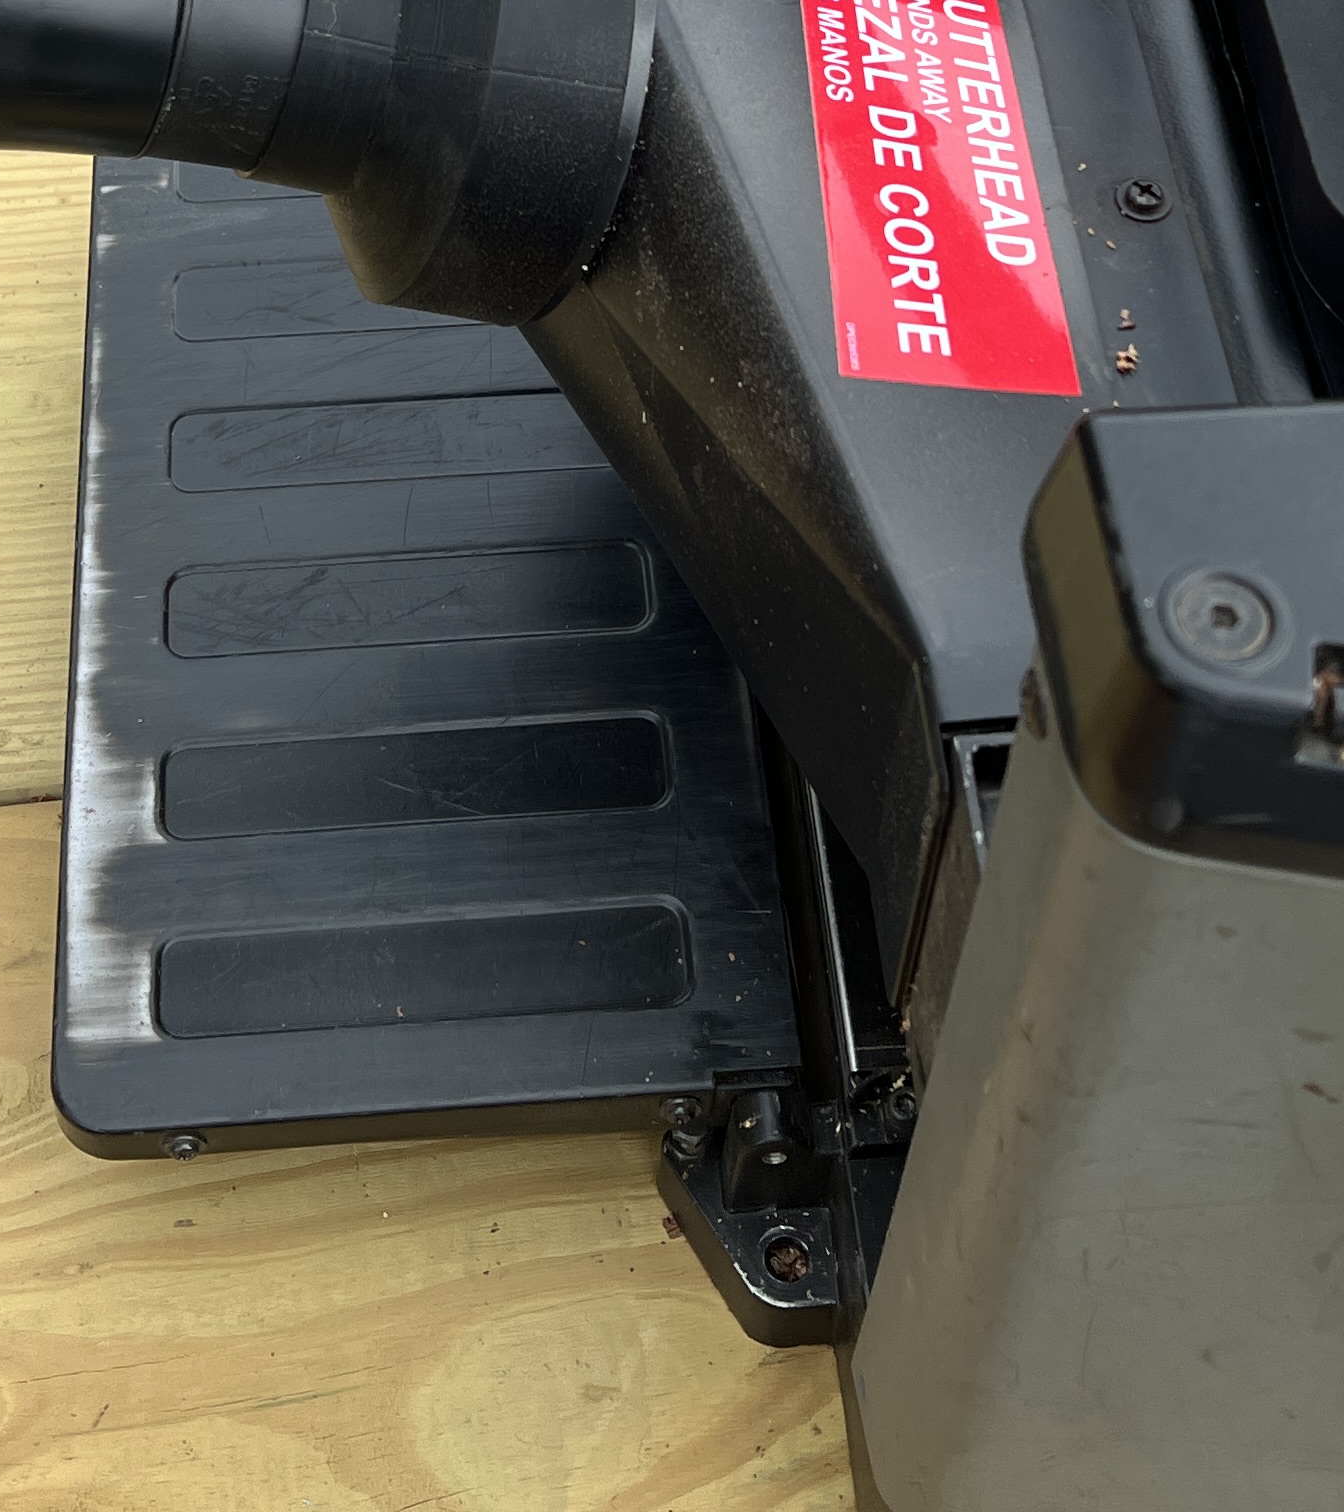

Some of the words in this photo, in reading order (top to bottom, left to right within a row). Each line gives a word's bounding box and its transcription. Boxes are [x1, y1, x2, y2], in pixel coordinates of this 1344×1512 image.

[816, 6, 854, 103] MANOS
[913, 47, 953, 125] AWAY
[868, 105, 923, 171] DE
[879, 183, 952, 357] CORTE
